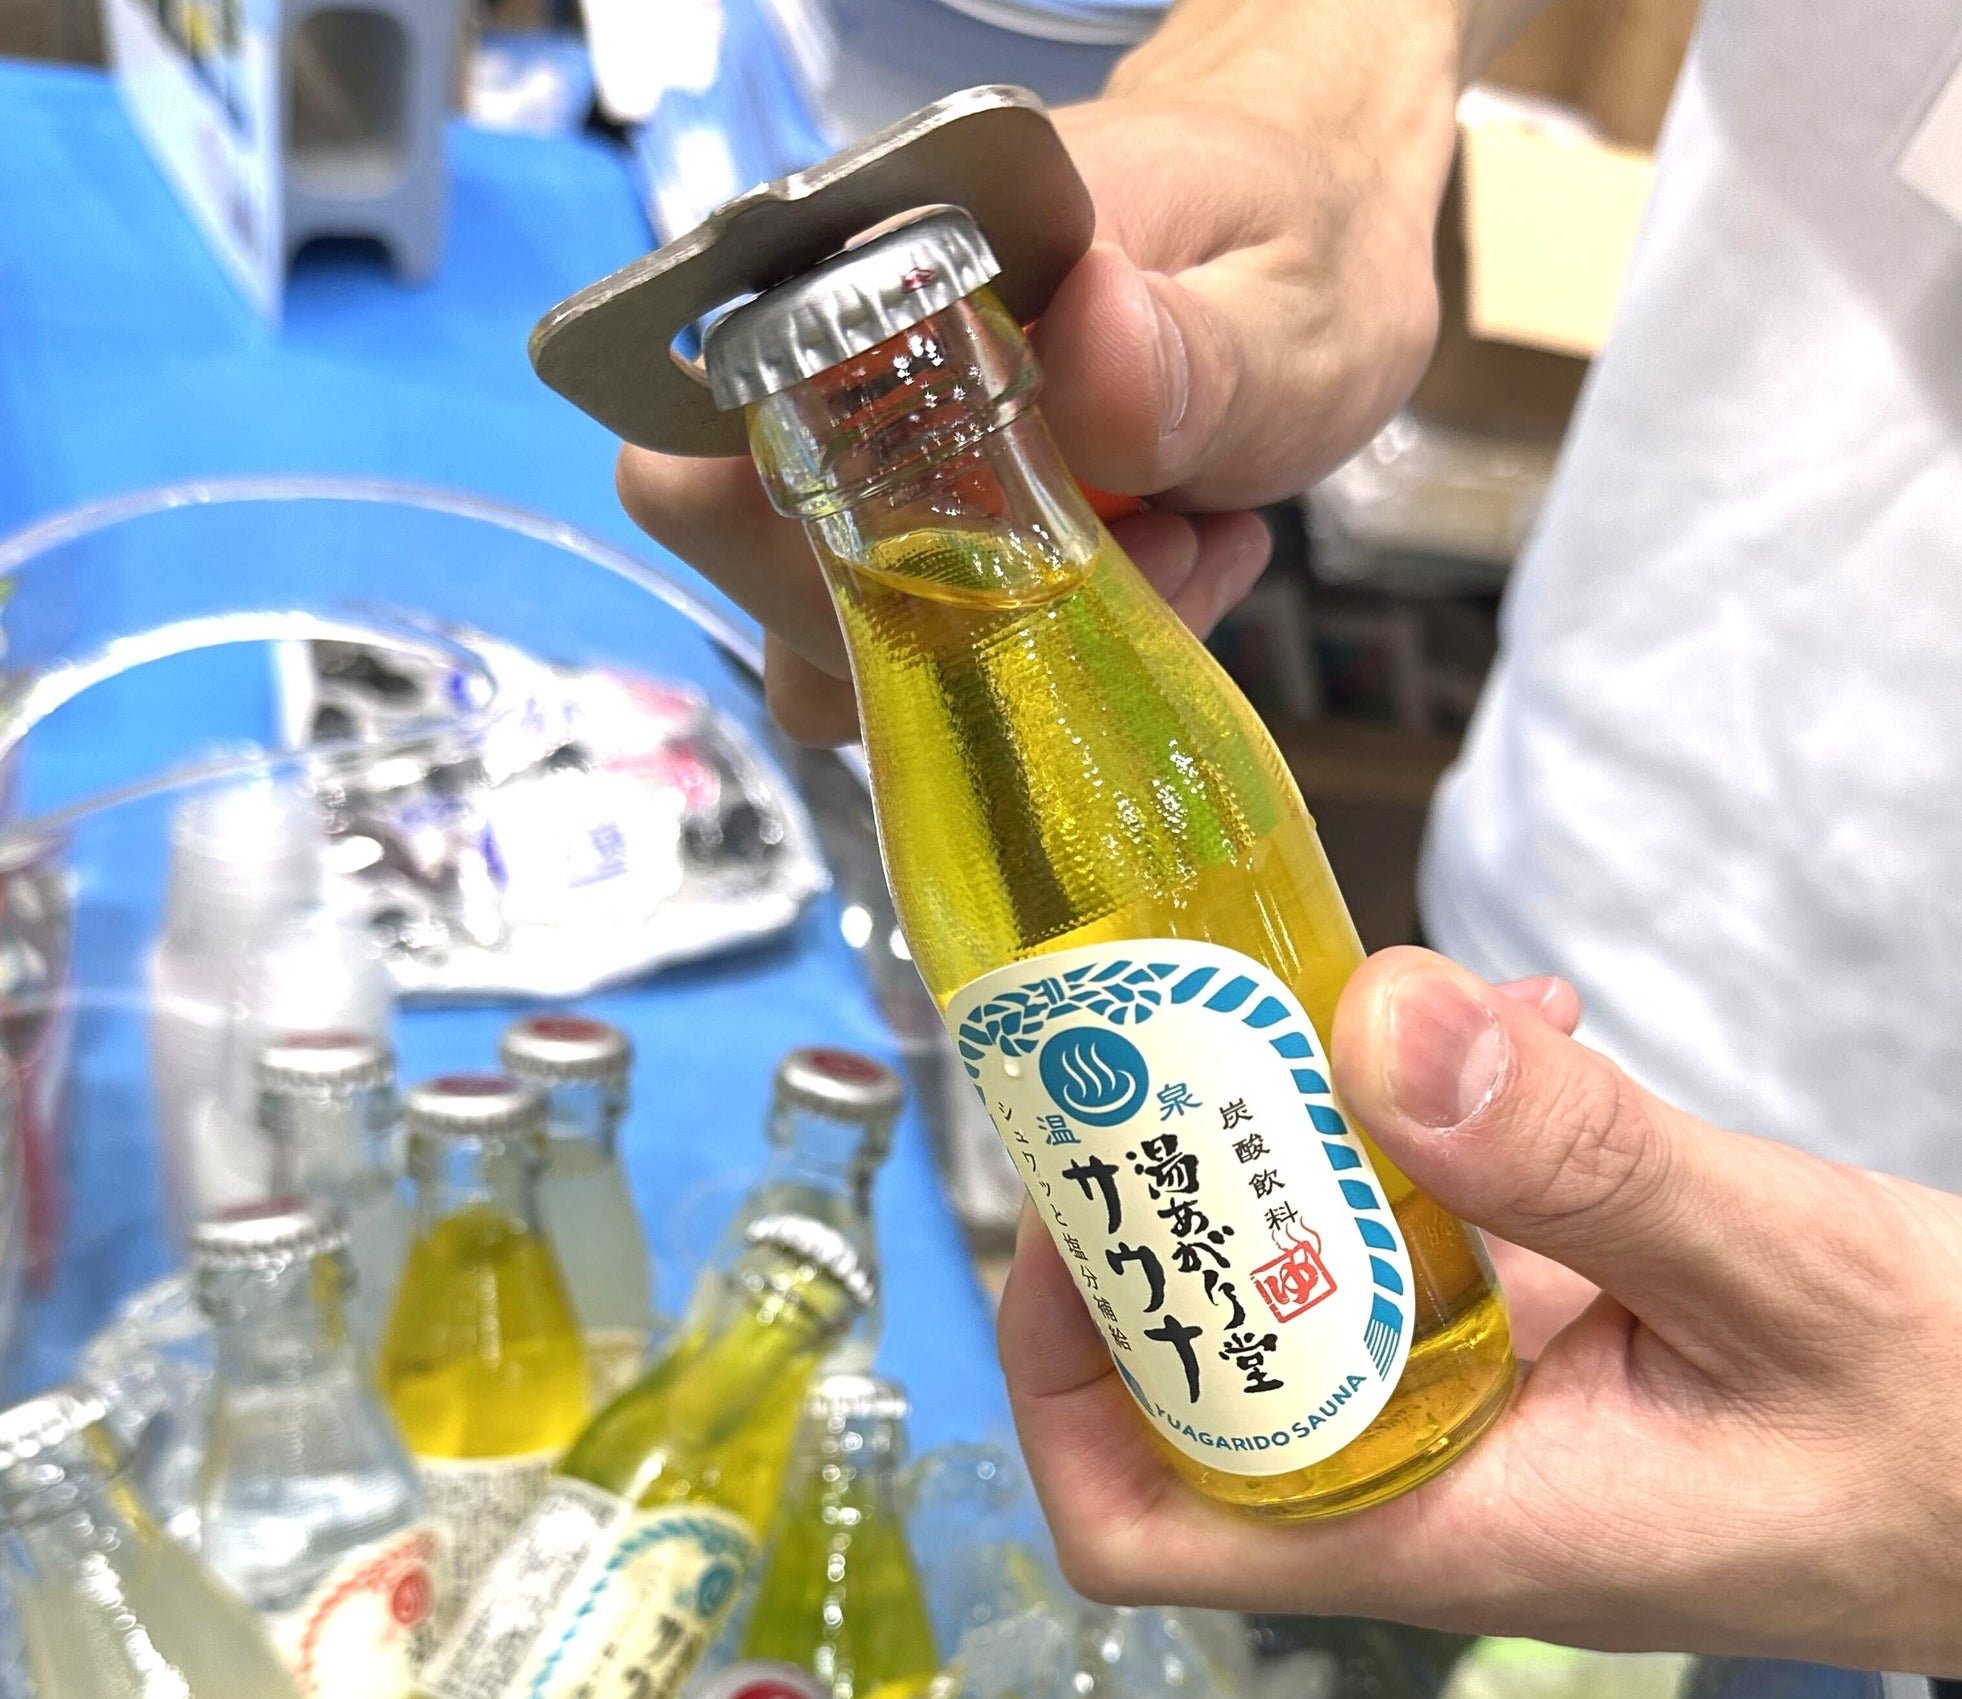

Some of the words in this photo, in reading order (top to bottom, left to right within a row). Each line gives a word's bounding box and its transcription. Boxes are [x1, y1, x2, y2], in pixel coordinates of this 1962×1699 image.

[1036, 1082, 1204, 1146] 温泉
[1219, 1097, 1299, 1231] 炭酸飲料
[997, 1101, 1132, 1352] シュワッと塩分補給
[1061, 1154, 1204, 1404] サウナ
[1125, 1133, 1285, 1394] 湯あがり堂
[1153, 1401, 1291, 1452] YUAGARIDO
[1291, 1373, 1367, 1439] SAUNA
